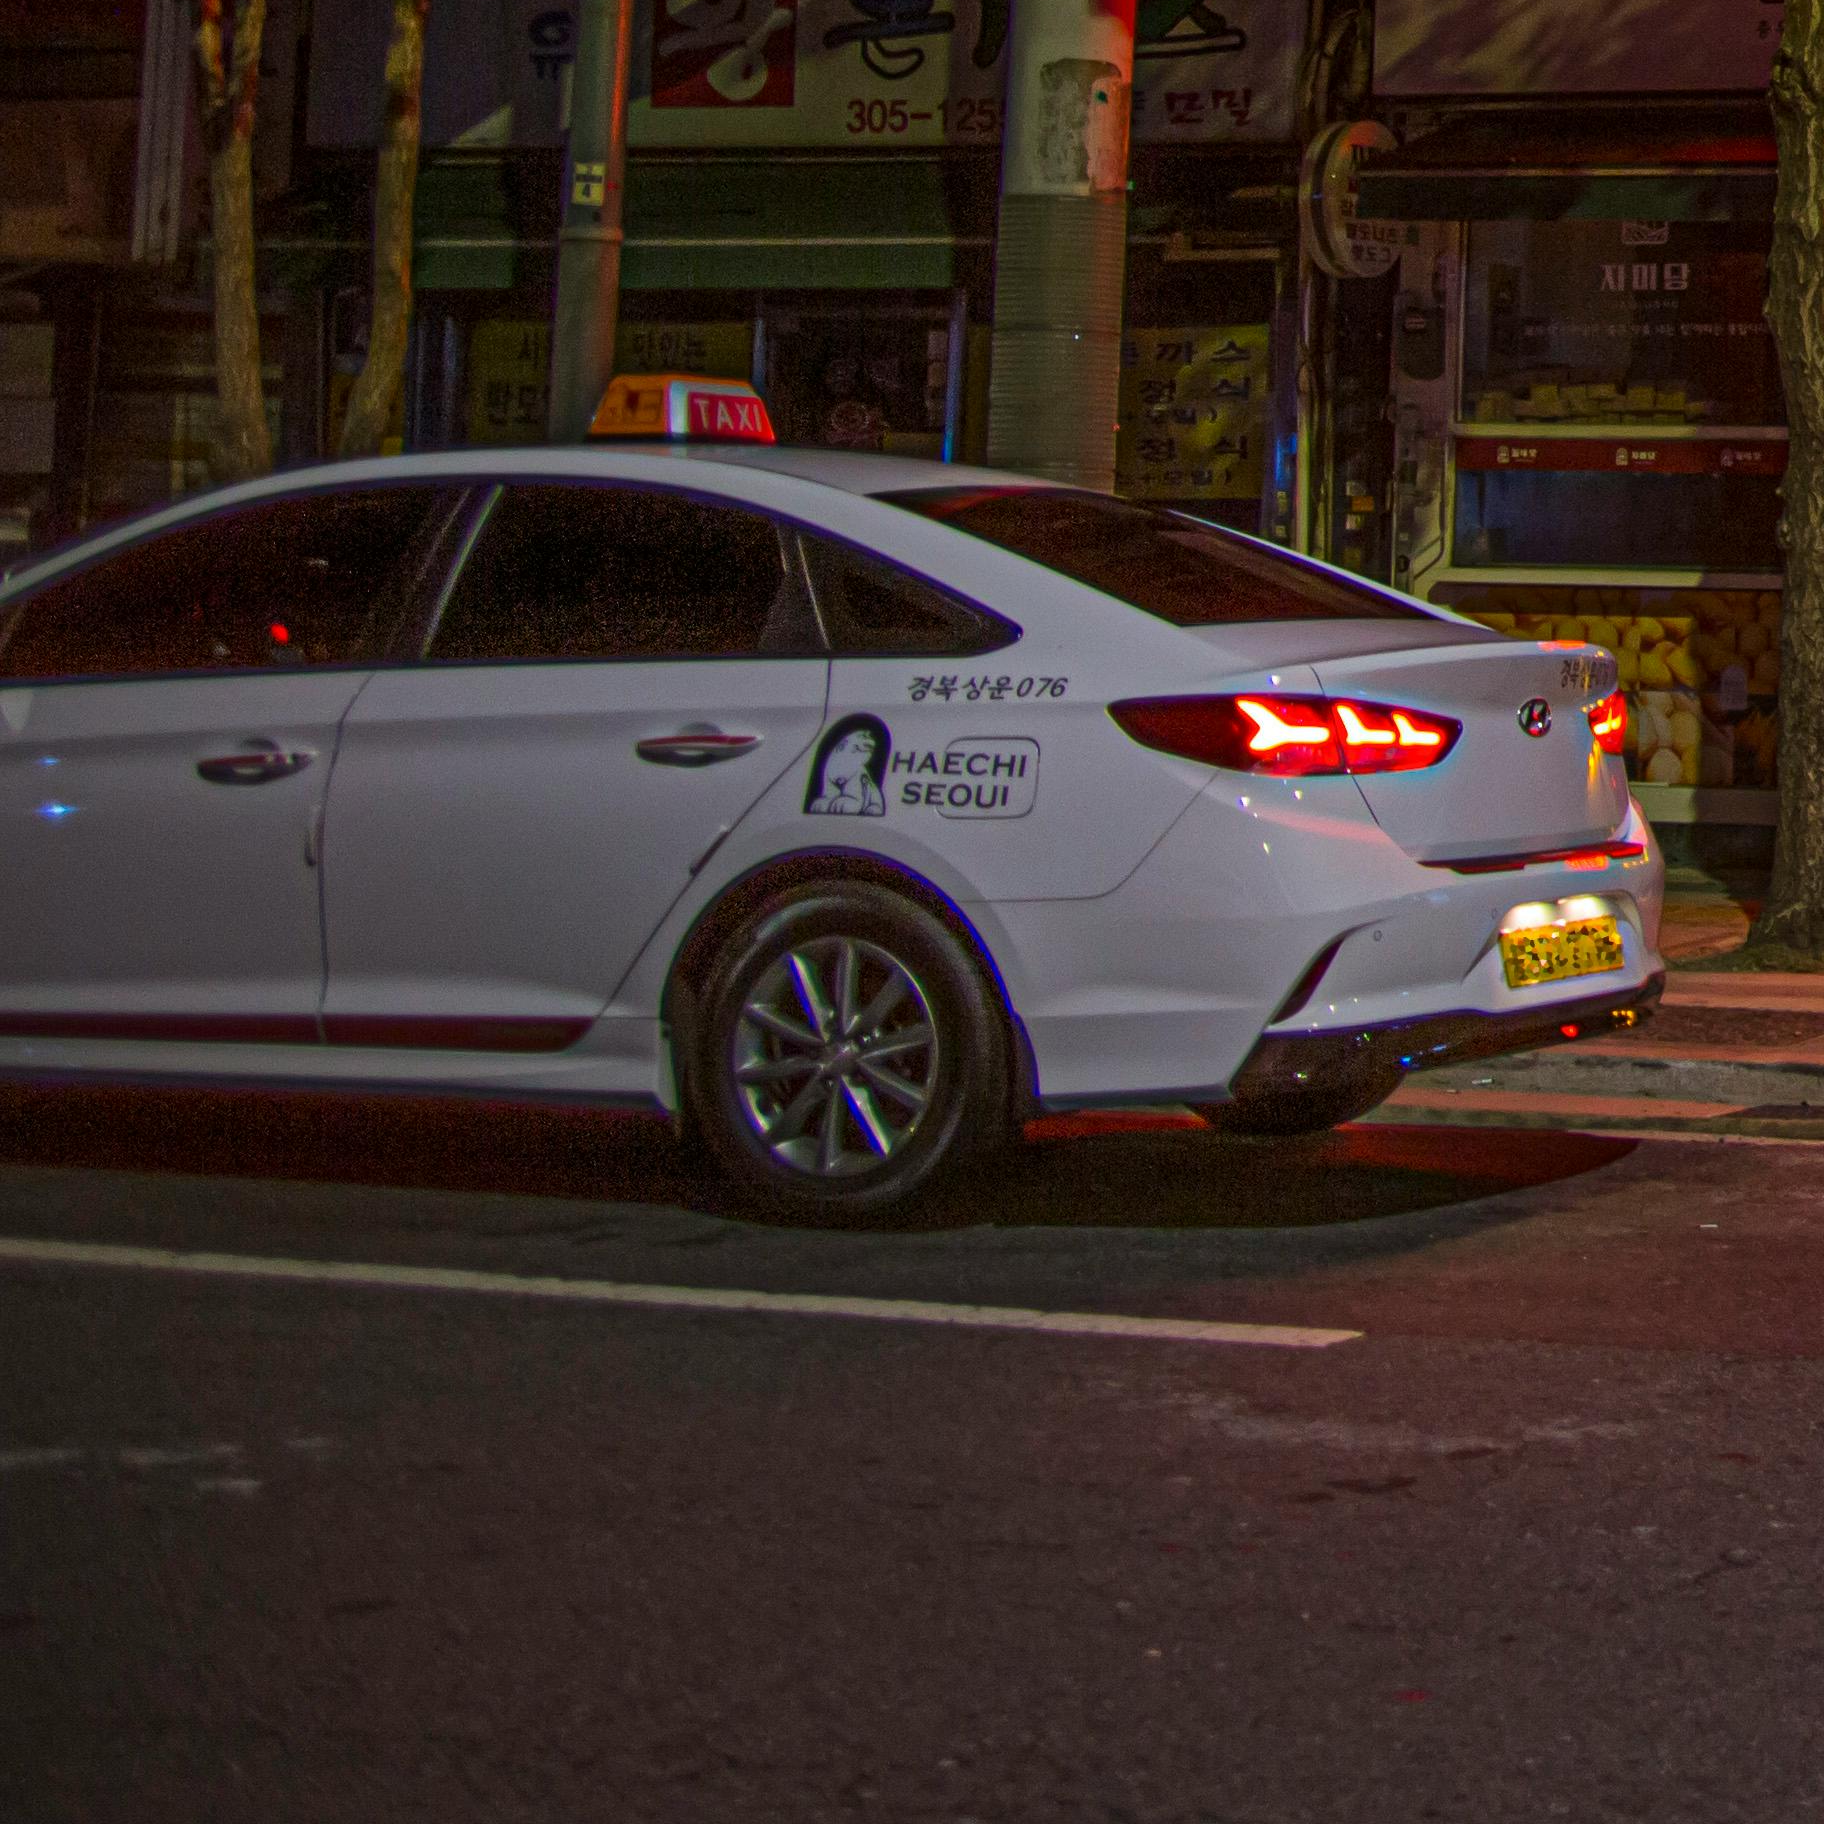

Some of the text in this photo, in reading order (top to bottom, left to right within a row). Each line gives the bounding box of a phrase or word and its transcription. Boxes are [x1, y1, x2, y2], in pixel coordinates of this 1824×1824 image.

[845, 97, 1006, 134] 305-125
[1600, 262, 1690, 293] 자미당
[693, 397, 763, 433] TAXI
[891, 750, 1028, 778] HAECHI
